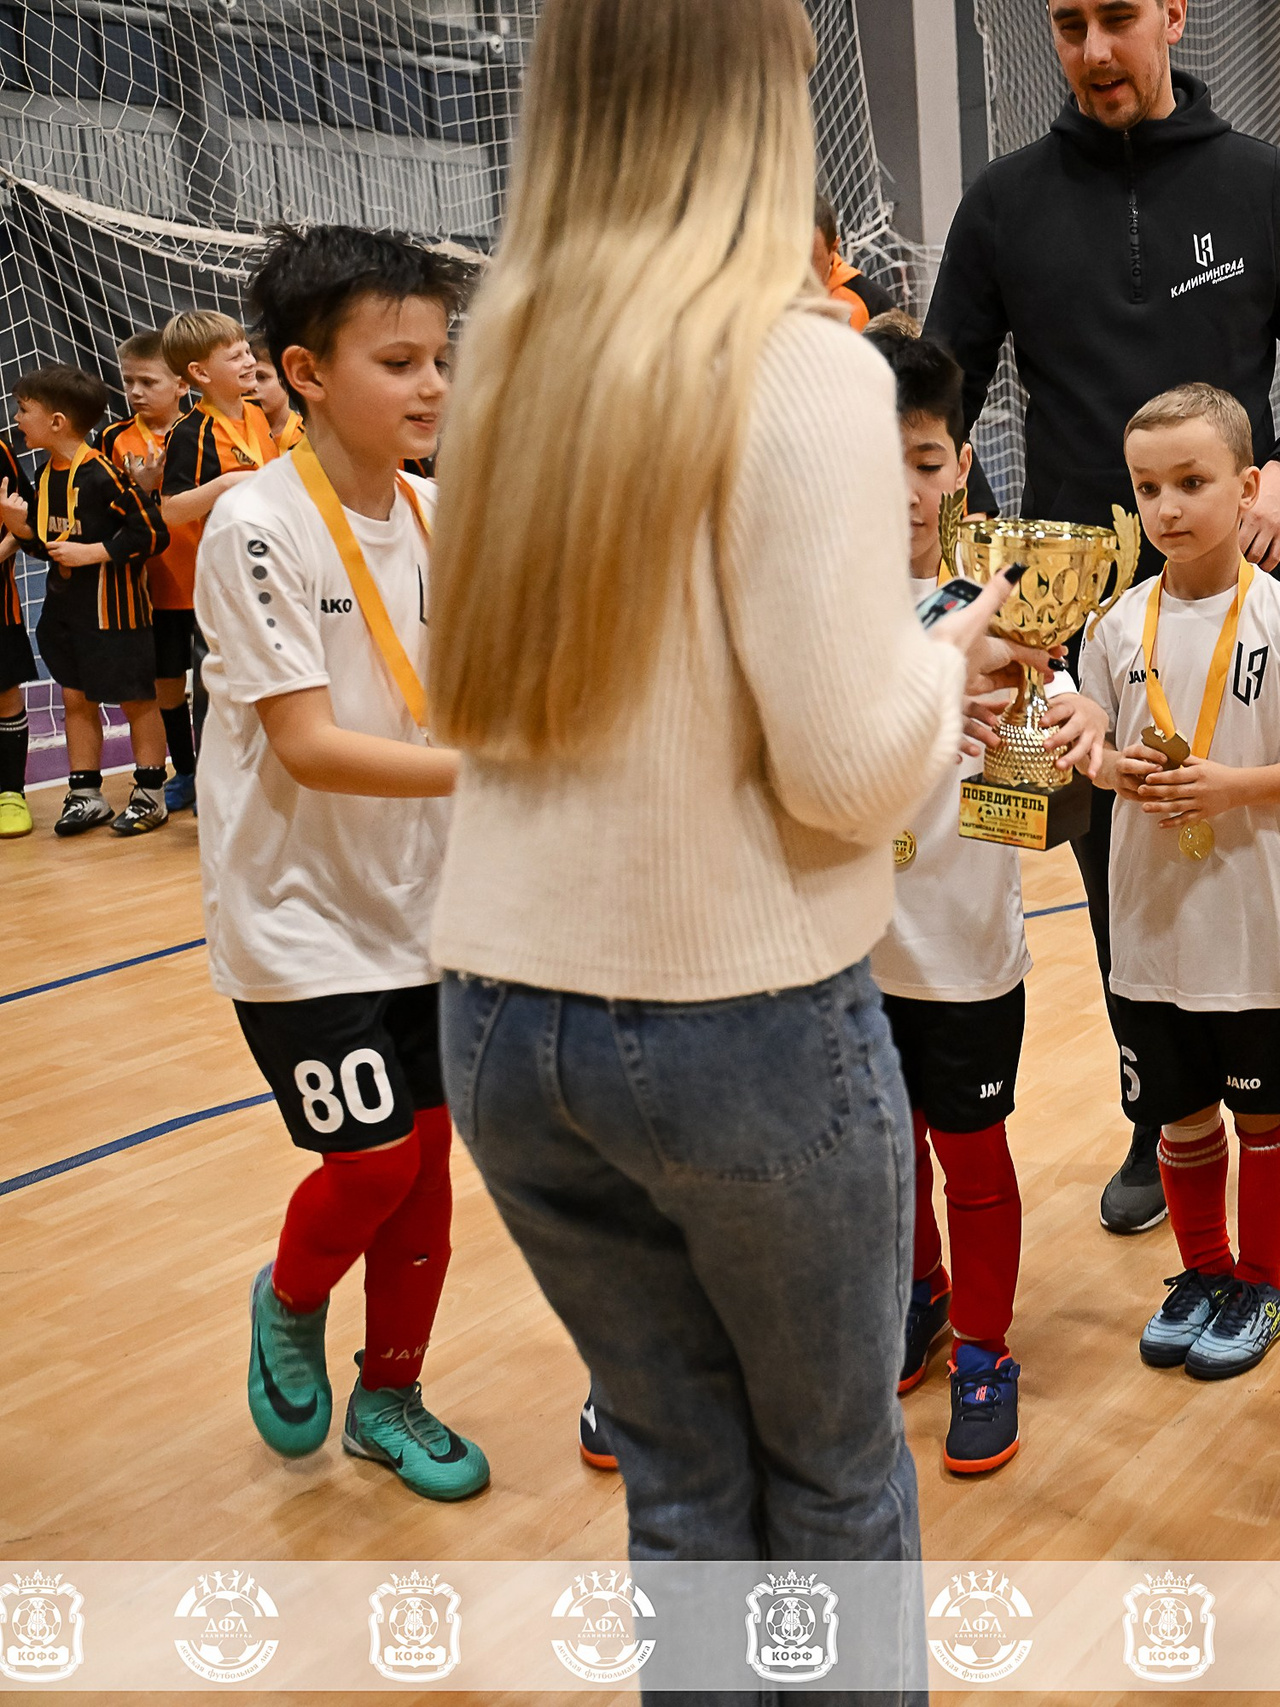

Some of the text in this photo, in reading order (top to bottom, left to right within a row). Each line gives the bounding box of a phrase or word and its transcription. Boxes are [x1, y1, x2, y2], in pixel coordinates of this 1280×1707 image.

[1170, 257, 1244, 298] КАЛИНИНГРАД
[320, 598, 352, 613] AKO
[962, 787, 1044, 811] ПОБЕДИТЕЛЬ
[294, 1048, 394, 1133] 80
[1226, 1075, 1261, 1090] JAKO
[381, 1341, 428, 1360] JAK
